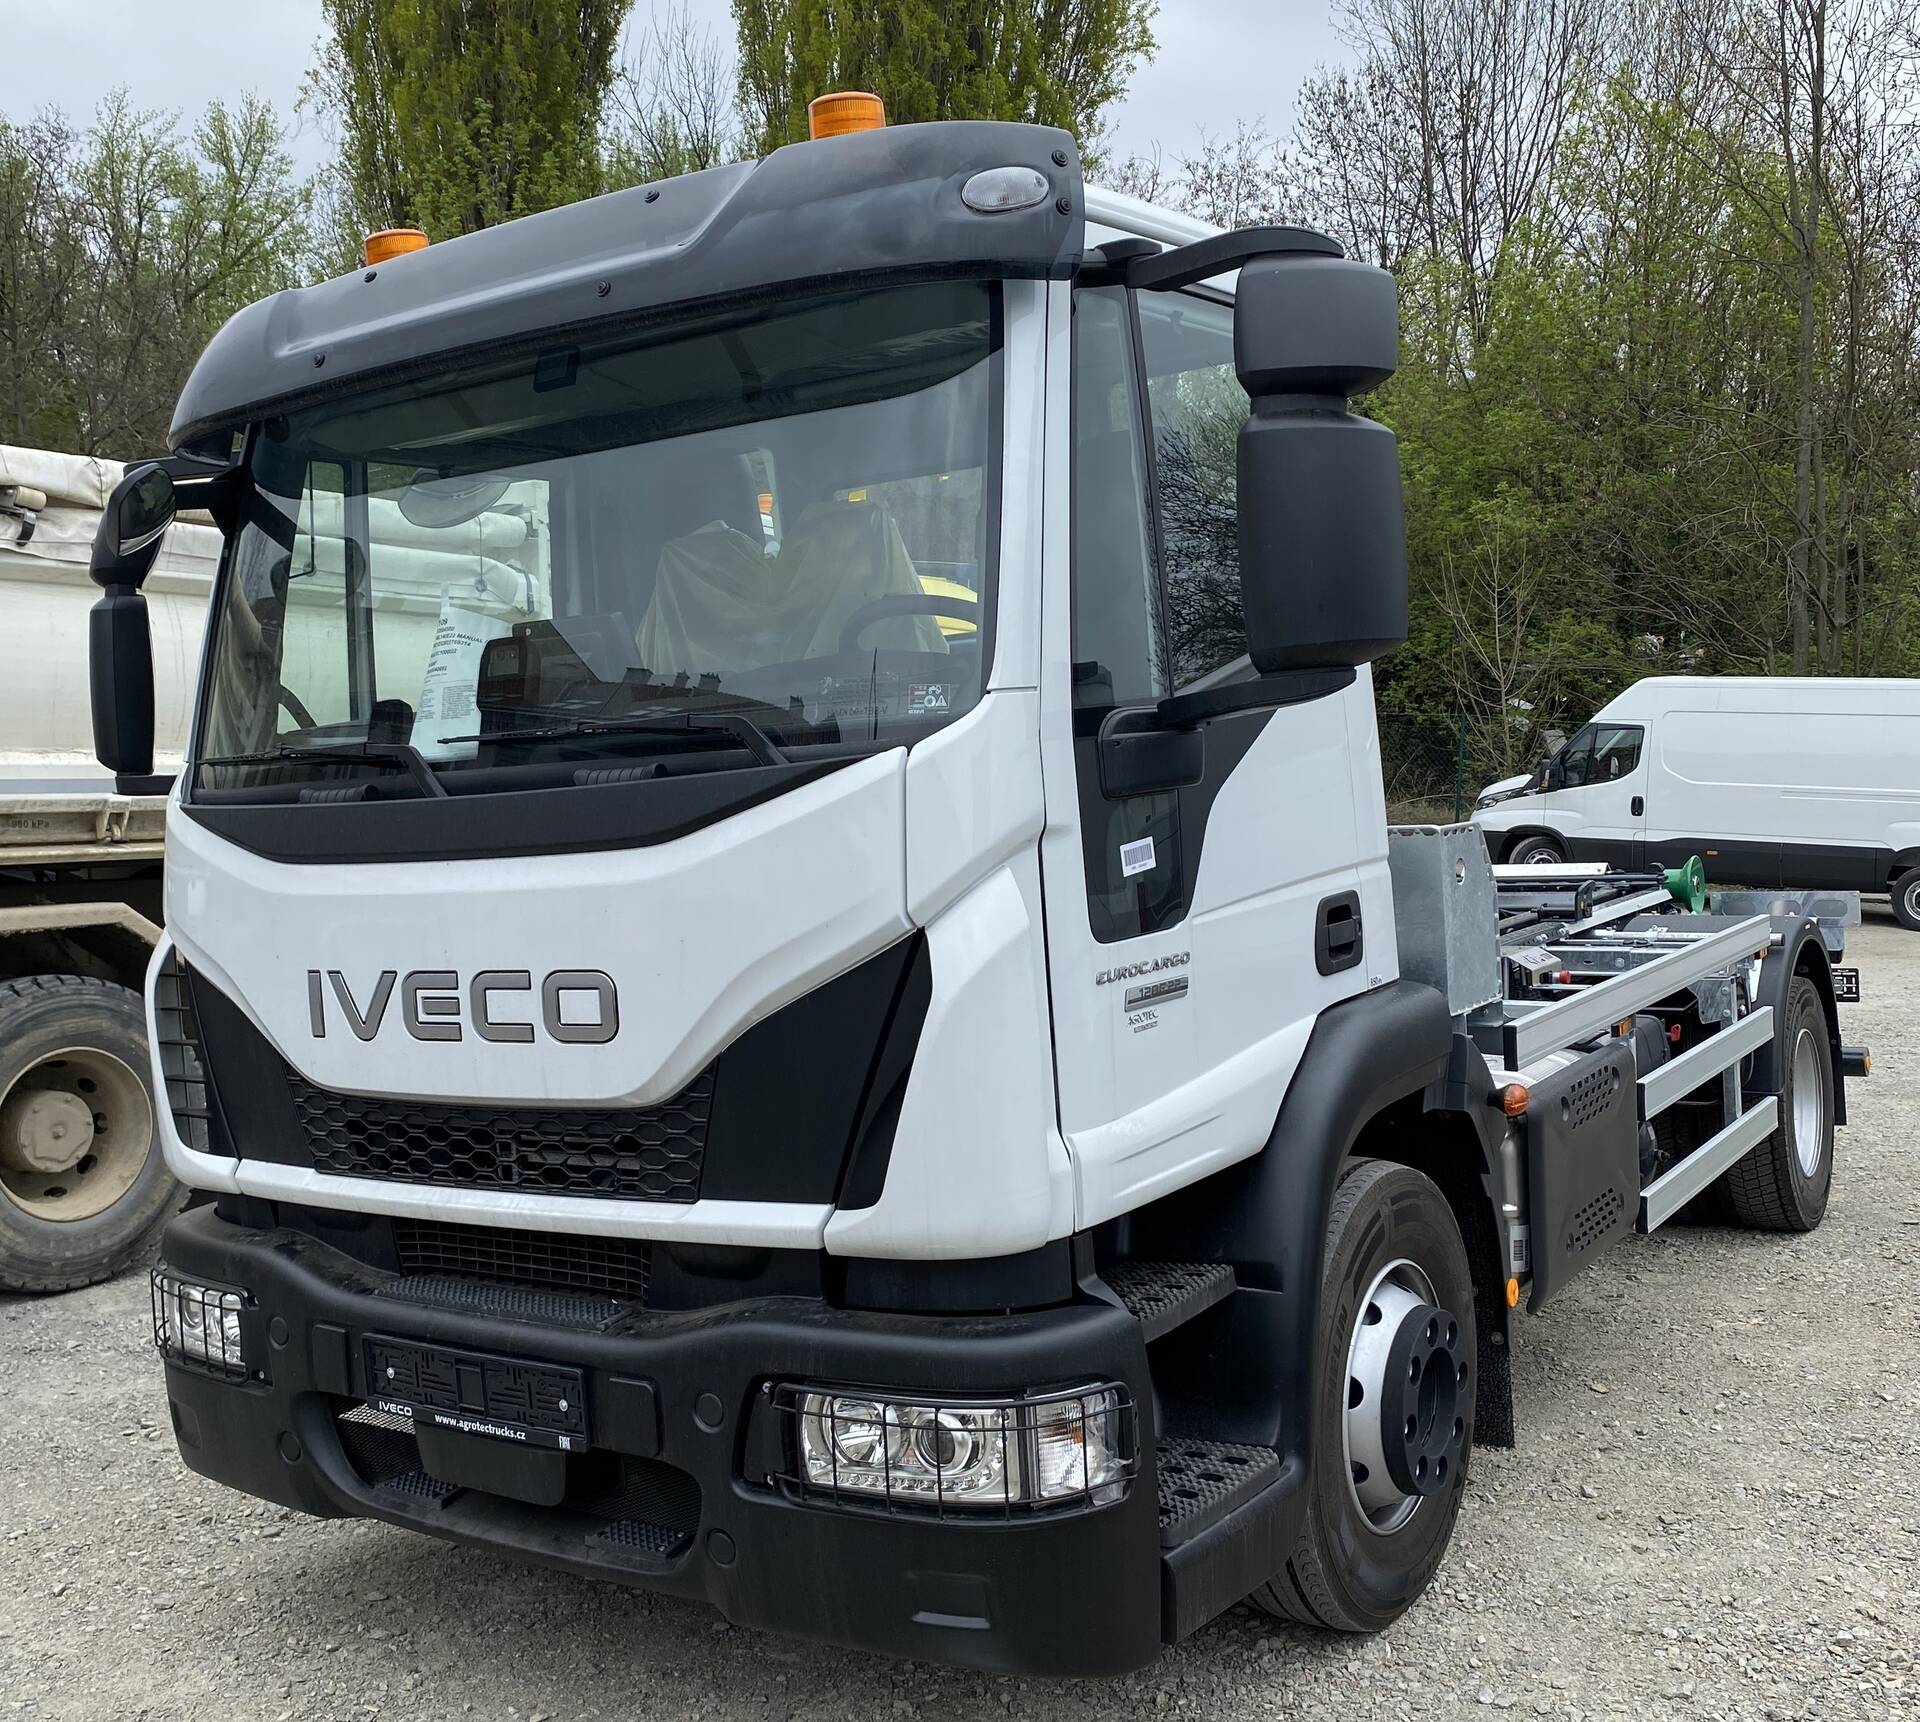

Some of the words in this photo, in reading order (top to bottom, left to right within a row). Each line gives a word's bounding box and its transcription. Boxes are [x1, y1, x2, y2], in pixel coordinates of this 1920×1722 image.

[1095, 951, 1191, 986] EUROCARGO
[307, 969, 620, 1044] IVECO
[379, 1401, 412, 1416] IVECO
[435, 1414, 526, 1441] www.agrotectrucks.cz
